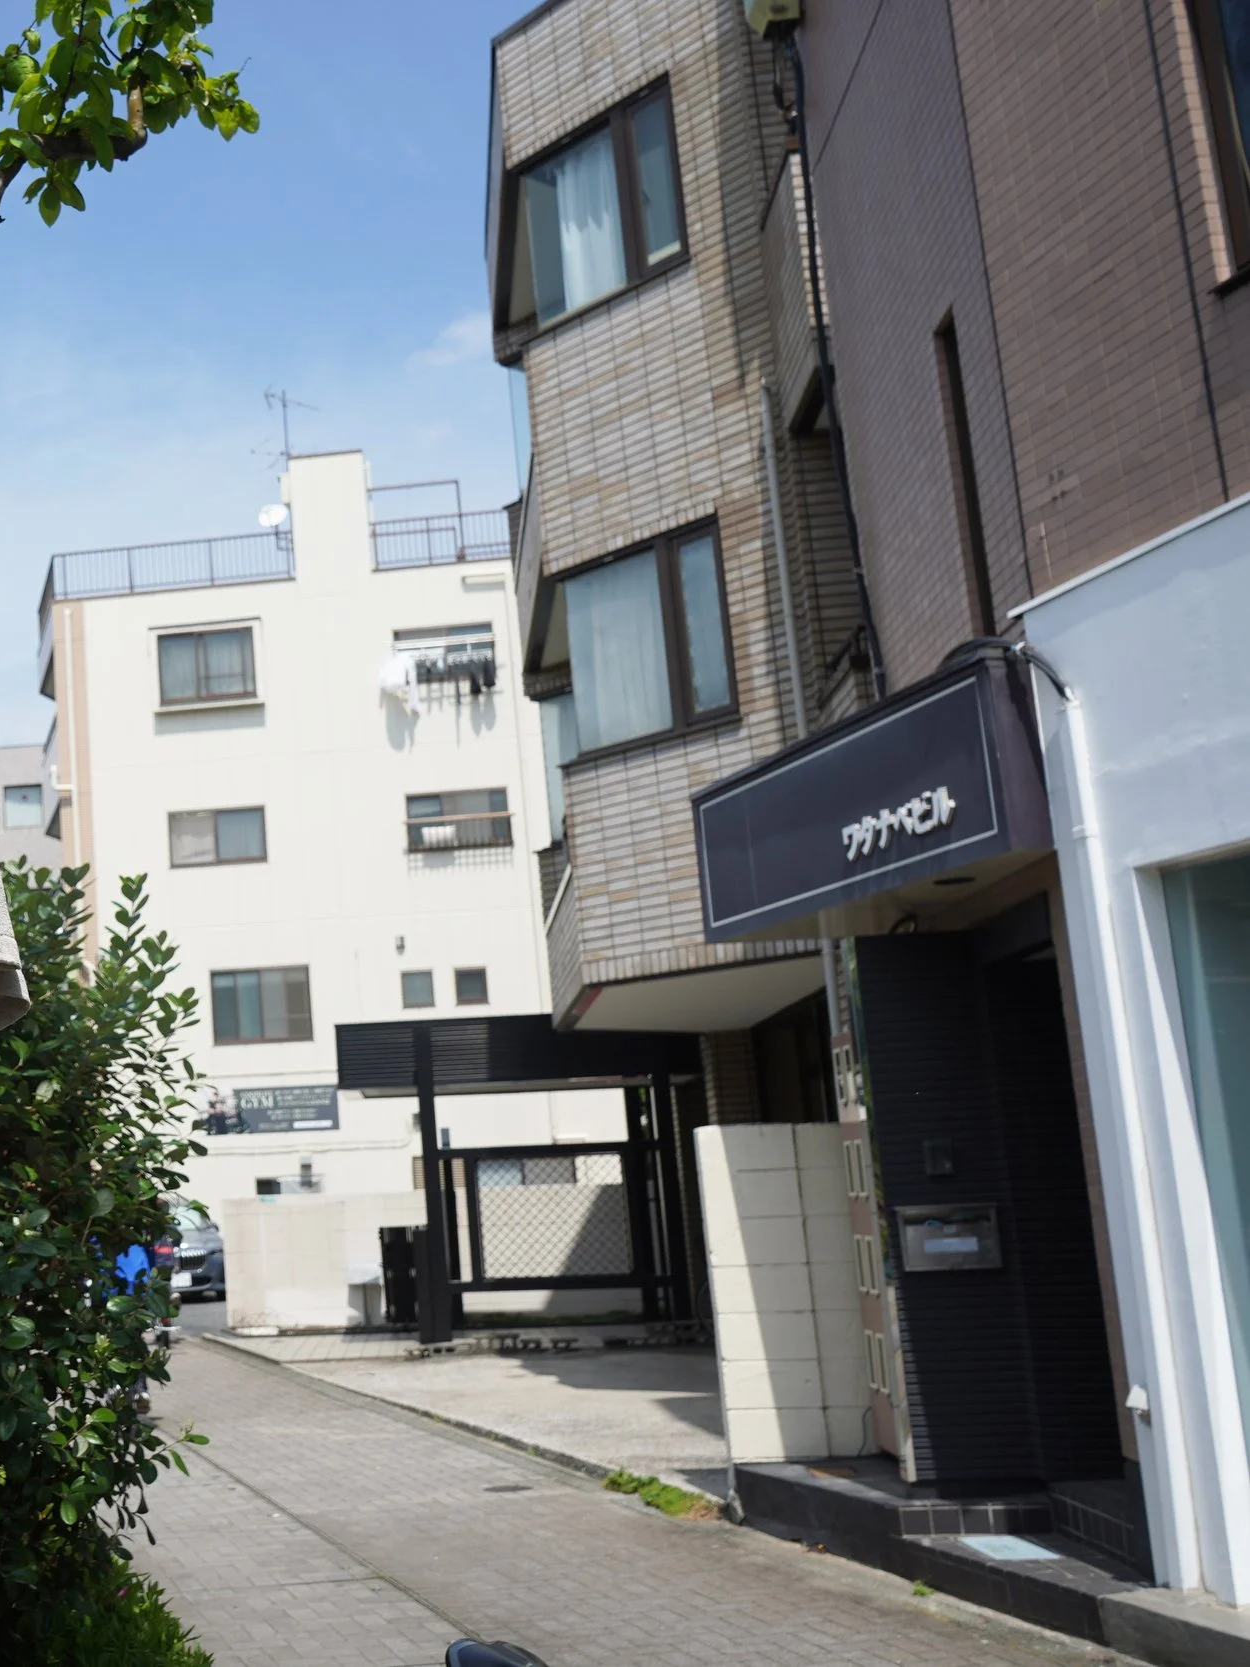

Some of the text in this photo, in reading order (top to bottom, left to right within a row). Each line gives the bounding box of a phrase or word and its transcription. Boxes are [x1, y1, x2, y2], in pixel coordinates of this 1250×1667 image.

[842, 786, 956, 861] ワタナベビル
